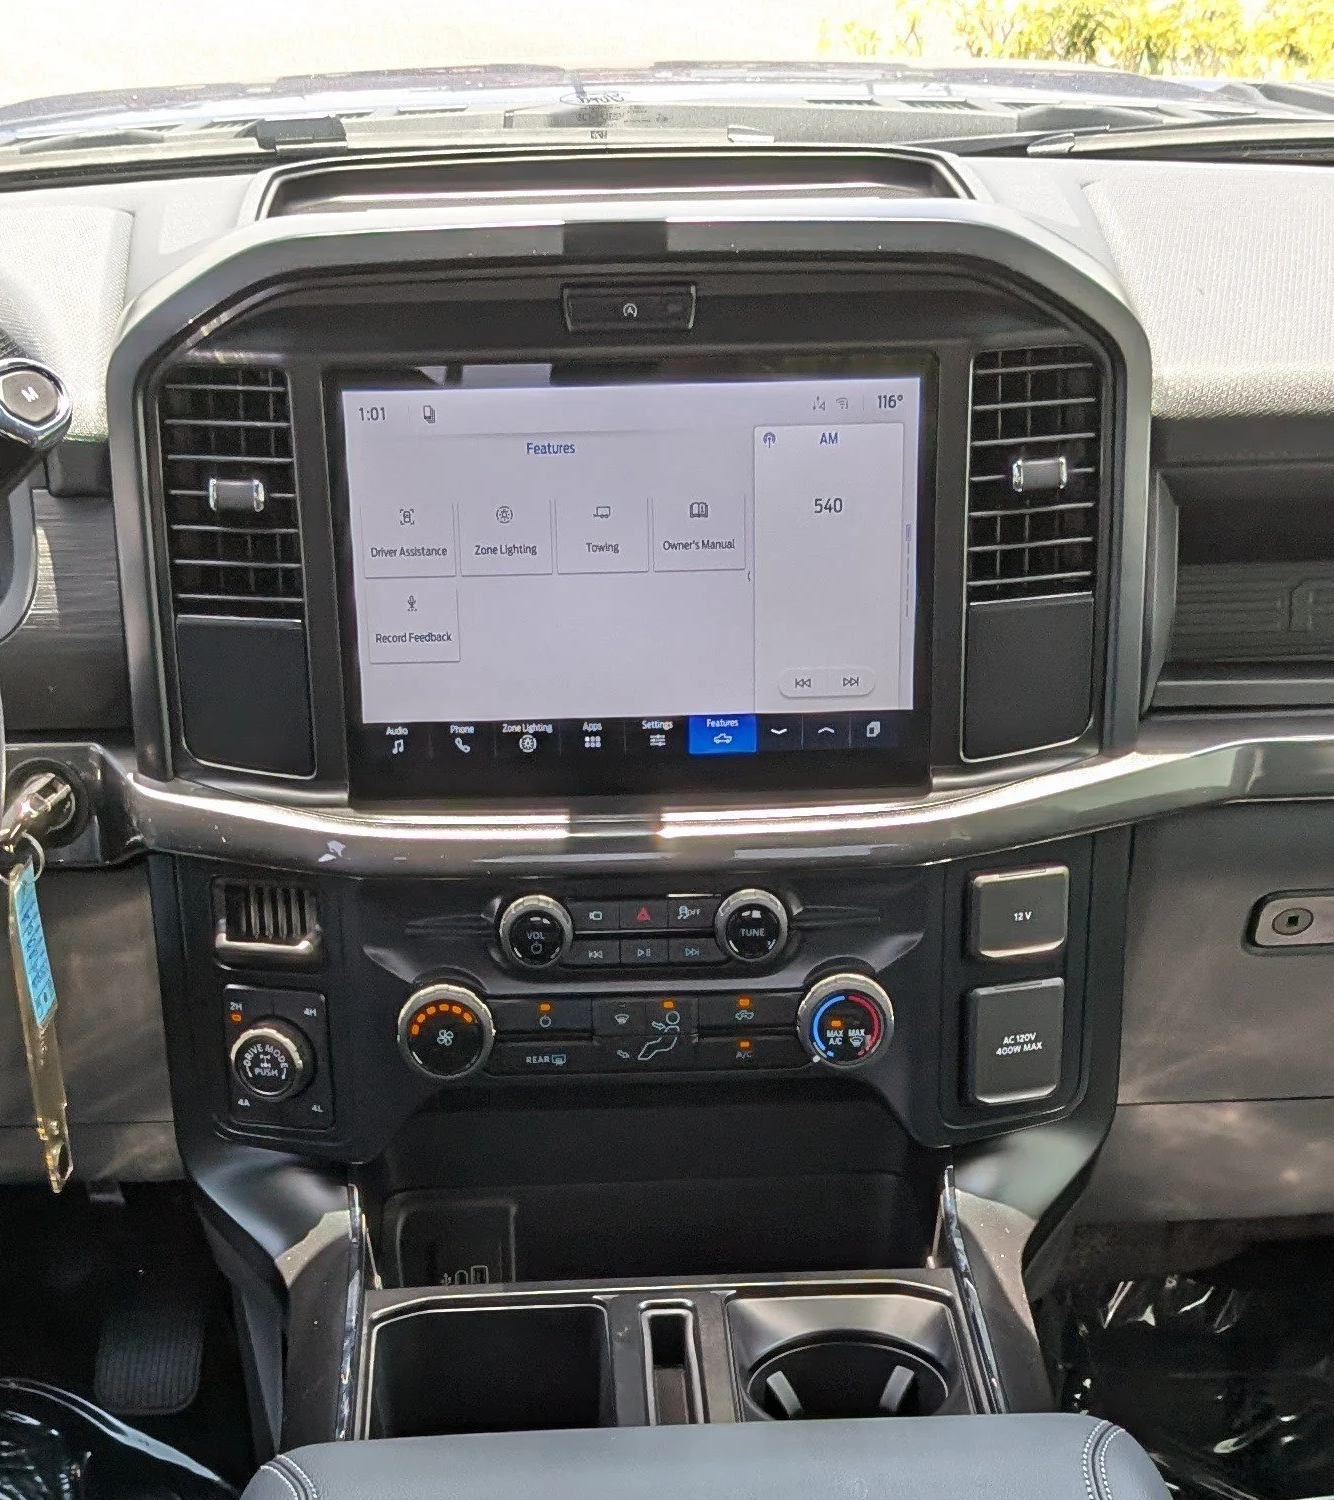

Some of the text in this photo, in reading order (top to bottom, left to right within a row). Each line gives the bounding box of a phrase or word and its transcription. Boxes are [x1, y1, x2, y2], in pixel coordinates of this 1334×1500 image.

[878, 394, 904, 409] 116°
[358, 406, 386, 421] 1:01
[819, 432, 839, 445] AM
[526, 442, 576, 455] Features
[814, 498, 843, 514] 540
[586, 541, 619, 554] Towing
[662, 538, 735, 551] Owner's Manual
[370, 546, 448, 558] Driver Assistance
[474, 544, 537, 556] Zone Lighting
[375, 631, 452, 643] Record Feedback
[583, 722, 603, 732] Apps
[641, 720, 673, 730] Settings
[706, 718, 739, 728] Features
[386, 726, 408, 736] Audio
[450, 724, 475, 734] Phone
[502, 723, 553, 734] Zone Lighting
[1013, 911, 1032, 921] 12 V
[526, 931, 545, 940] VOL
[739, 928, 765, 937] TUNE
[229, 1002, 243, 1011] 2H
[304, 1008, 317, 1016] 4H
[827, 1029, 844, 1037] MAX
[848, 1029, 865, 1037] MAX
[829, 1037, 842, 1045] A/C
[1003, 1032, 1037, 1045] AC 120V
[996, 1042, 1043, 1056] 400W MAX
[243, 1043, 288, 1068] DRIVE MODE
[526, 1055, 550, 1064] REAR
[736, 1051, 751, 1059] A/C
[254, 1068, 278, 1076] PUSH
[238, 1099, 250, 1107] 4A
